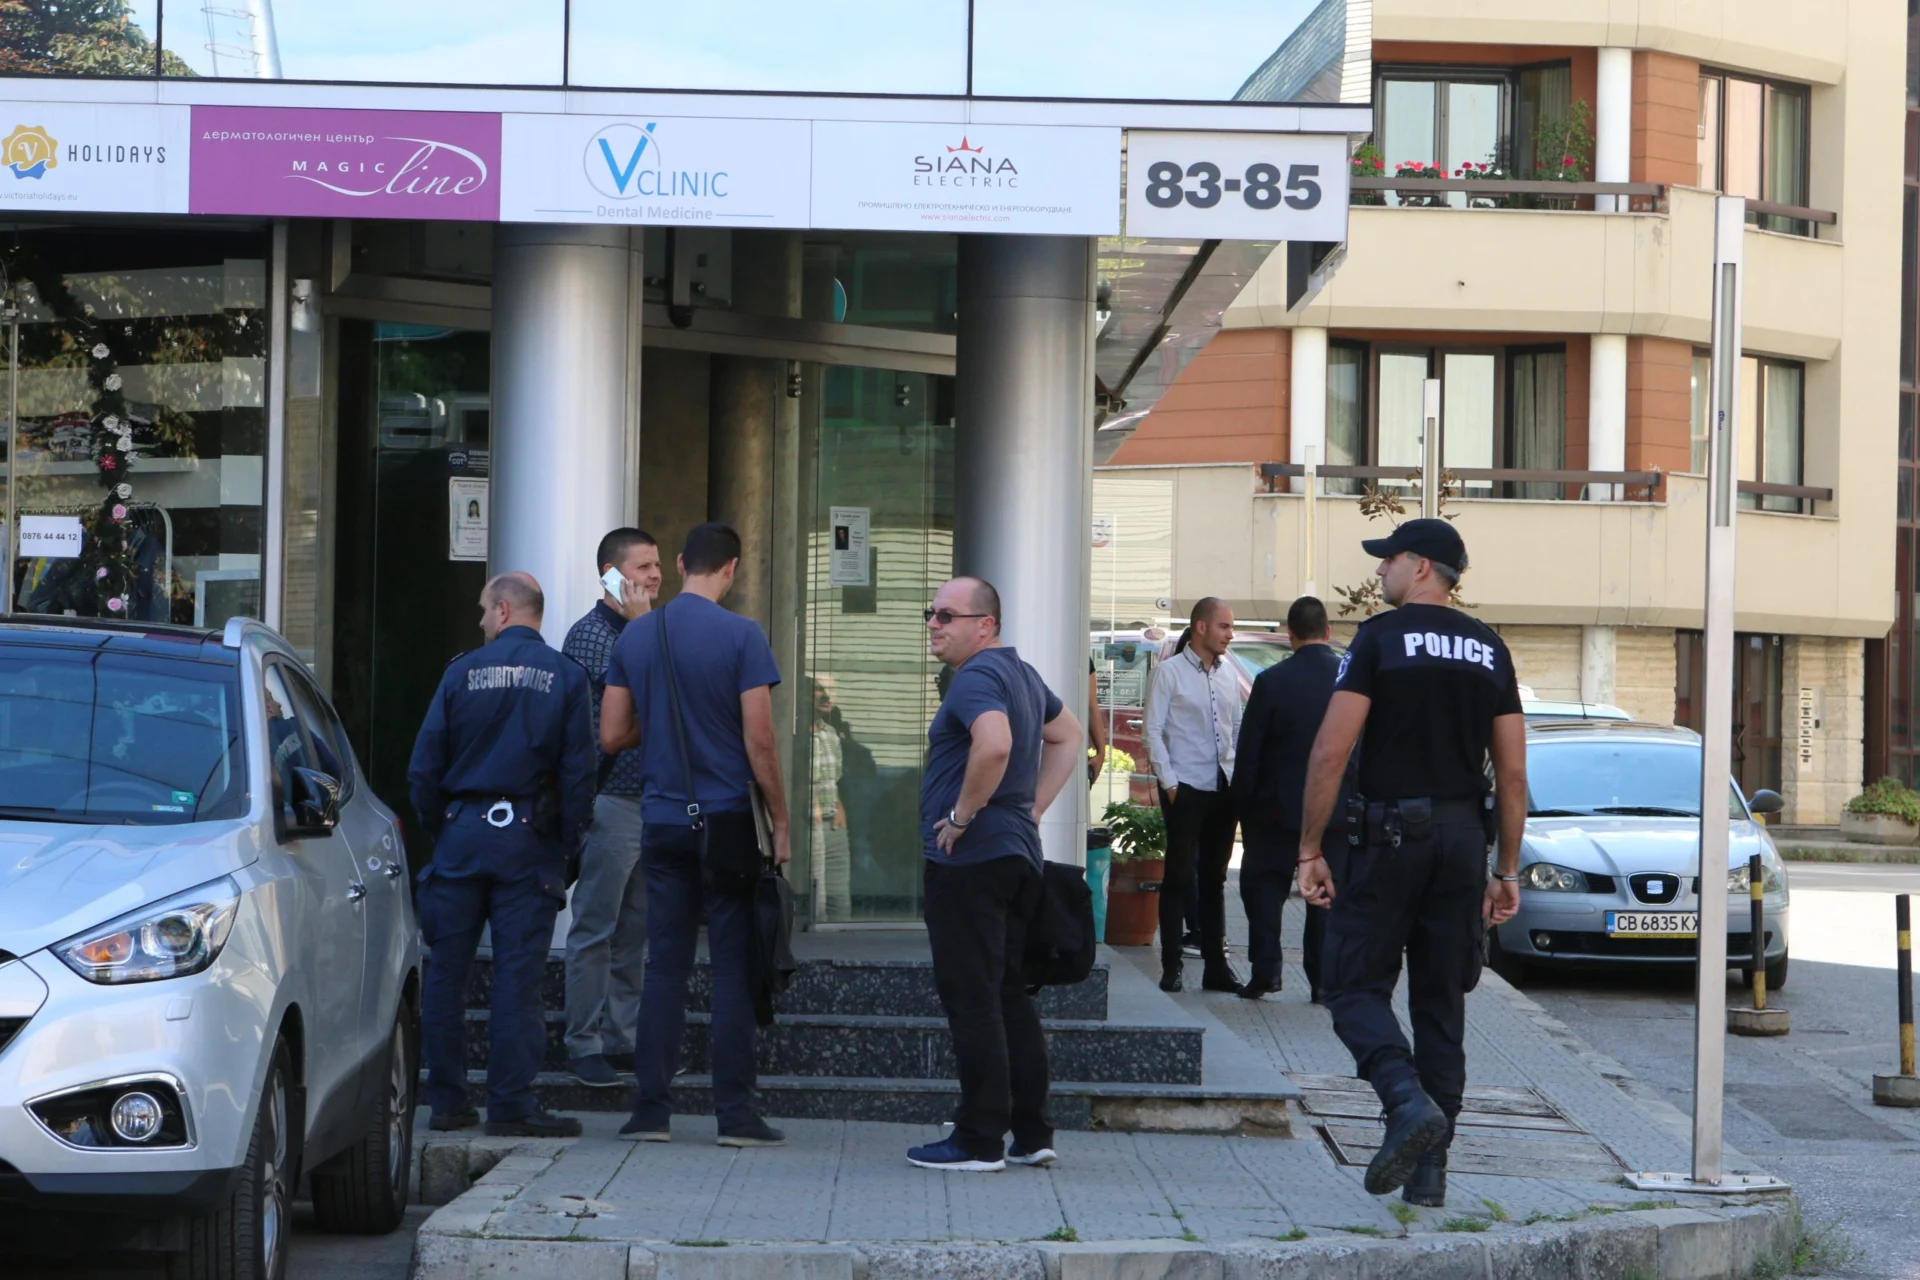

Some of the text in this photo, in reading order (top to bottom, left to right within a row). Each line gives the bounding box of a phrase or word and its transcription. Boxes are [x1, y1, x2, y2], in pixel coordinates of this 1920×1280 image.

[202, 130, 375, 144] дерматологичен център
[68, 144, 166, 164] HOLIDAYS
[292, 142, 476, 195] MAGIC line
[914, 155, 1018, 175] SIANA
[913, 175, 1018, 188] ELECTRIC
[1145, 161, 1322, 211] 83-85
[596, 204, 713, 220] Dental Medicine
[858, 201, 912, 210] ПРОМИШЛЕНО
[921, 213, 1011, 223] www.sianaelectric.com
[22, 532, 42, 540] 0876
[44, 532, 53, 540] 44
[67, 533, 78, 541] 12
[1403, 631, 1495, 671] POLICE
[468, 665, 555, 694] SECURITY POLICE
[1617, 916, 1638, 931] CB
[1640, 915, 1678, 931] 6835
